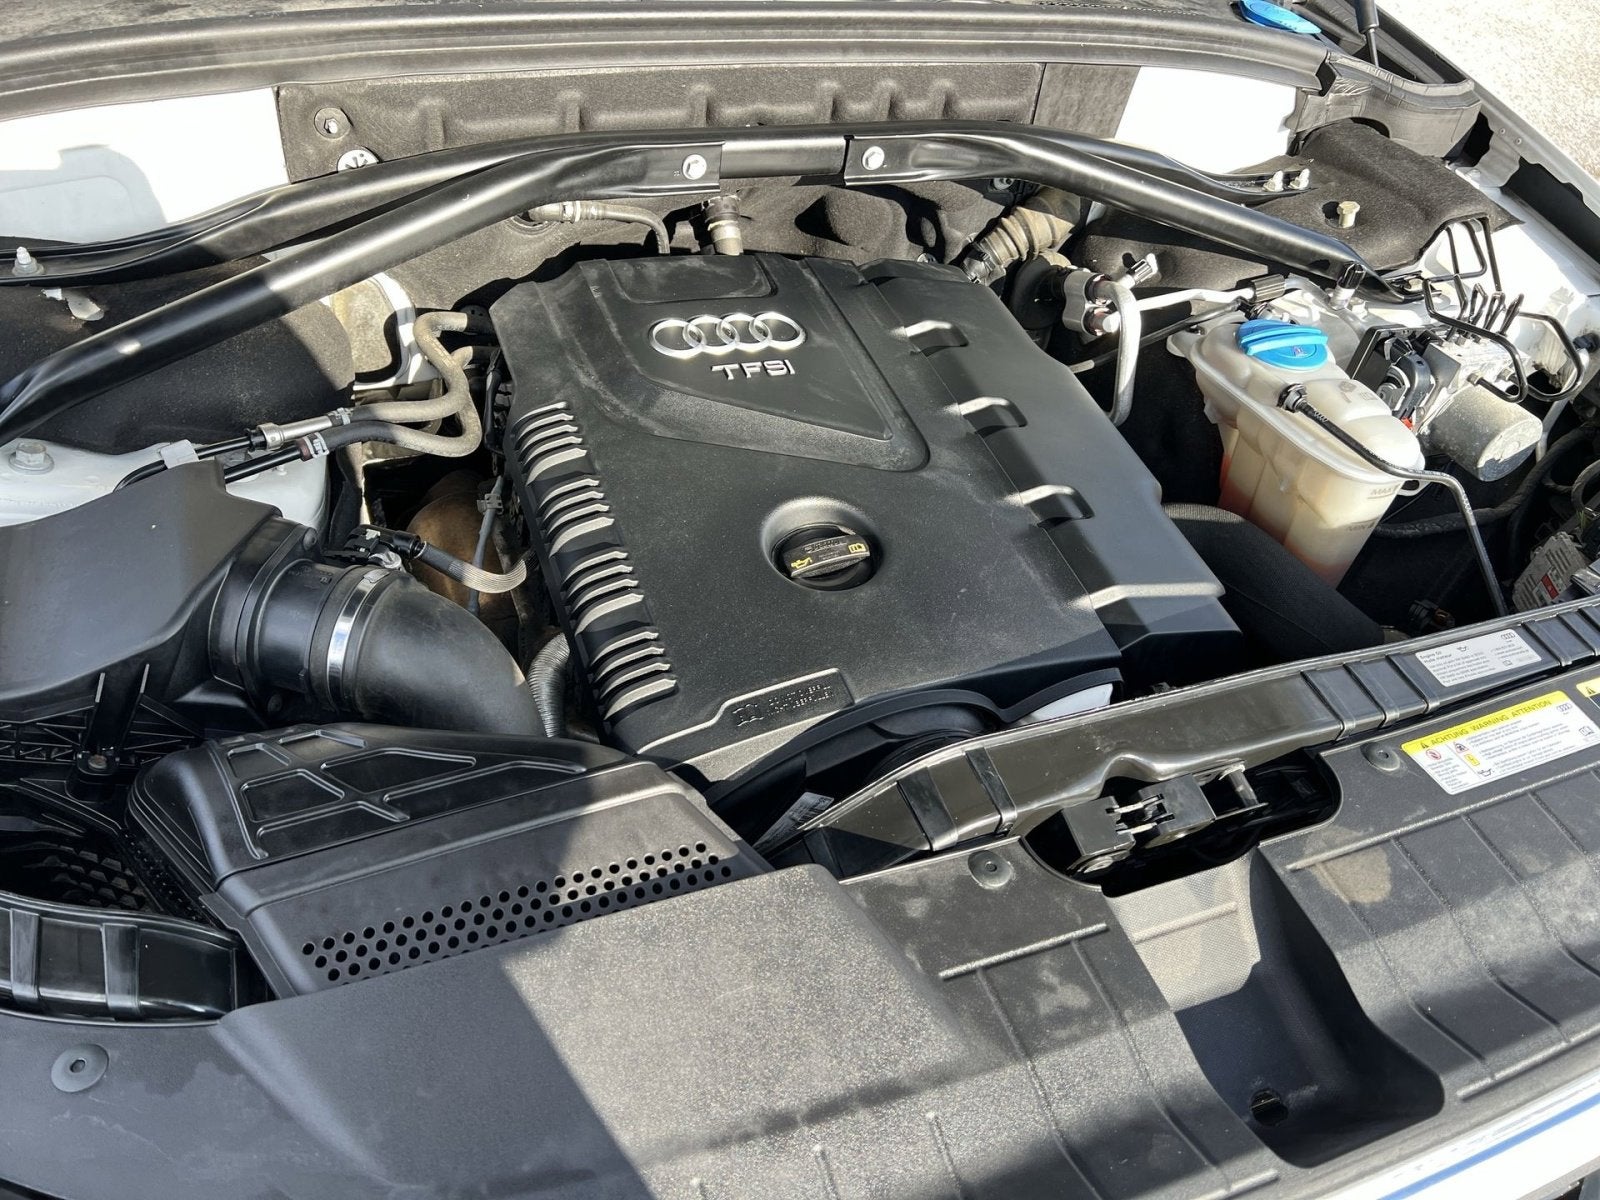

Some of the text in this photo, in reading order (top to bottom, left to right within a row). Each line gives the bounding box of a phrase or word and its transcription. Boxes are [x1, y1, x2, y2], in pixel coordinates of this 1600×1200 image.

[710, 359, 796, 381] TFSI
[1431, 728, 1469, 746] ACHTUNG
[1472, 714, 1509, 732] WARNING
[1511, 700, 1552, 718] ATTENTION
